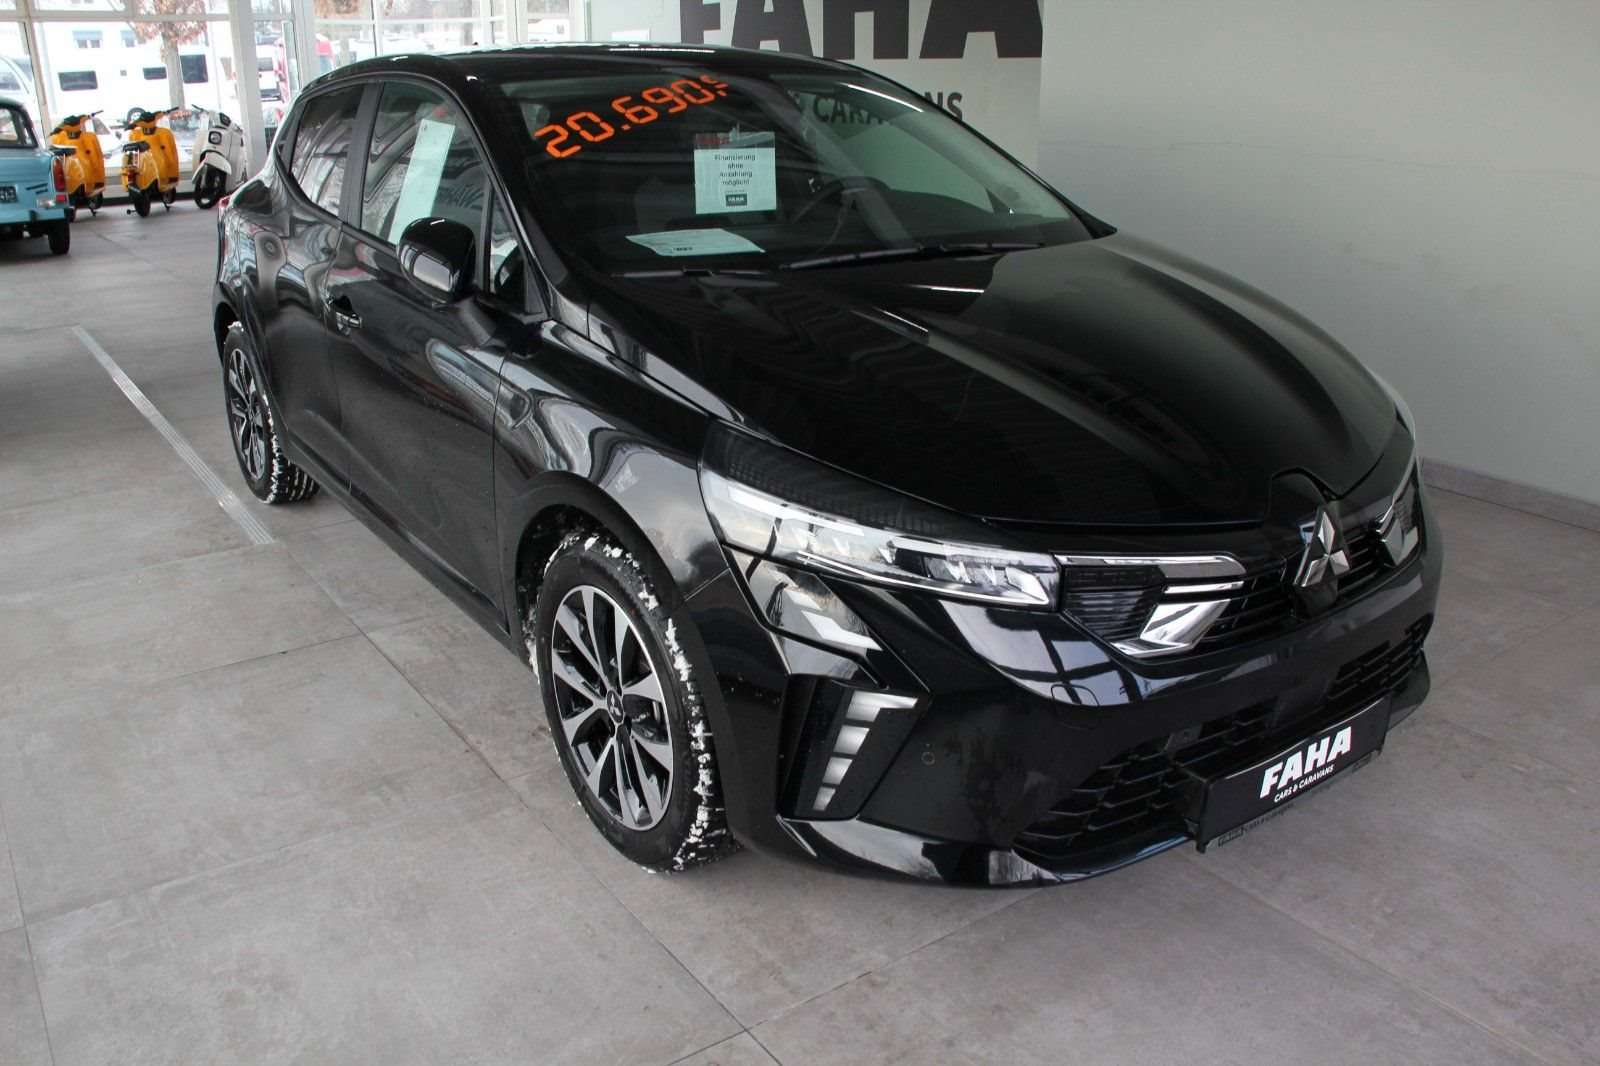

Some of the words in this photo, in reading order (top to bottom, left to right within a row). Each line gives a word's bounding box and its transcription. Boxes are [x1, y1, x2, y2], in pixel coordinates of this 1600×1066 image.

[1259, 726, 1352, 799] FAHA
[1274, 786, 1292, 803] CARS
[1298, 764, 1335, 789] CARAVANS
